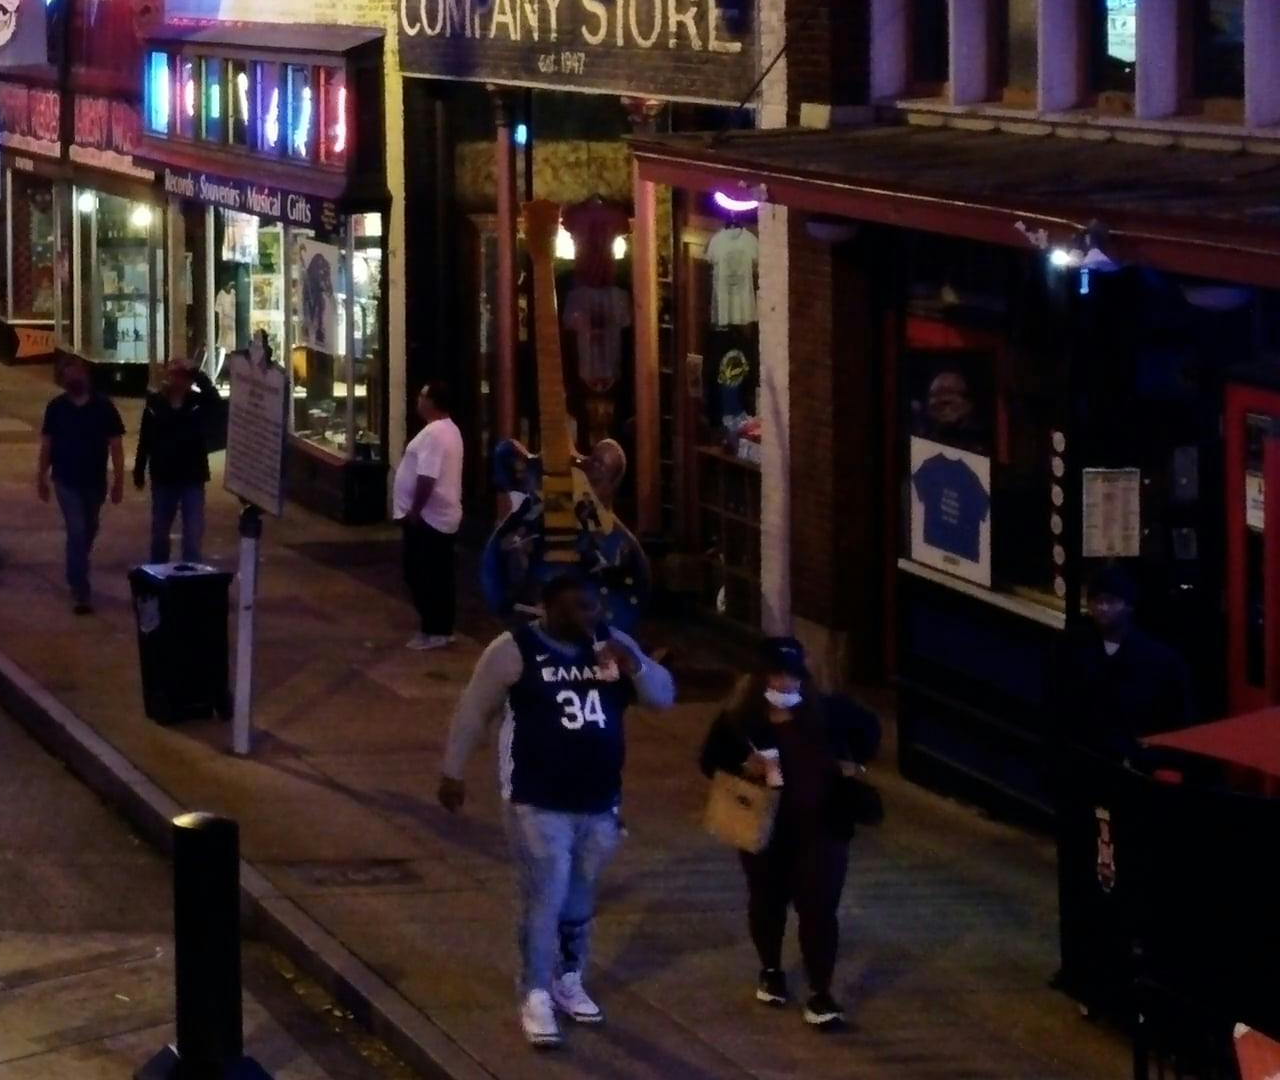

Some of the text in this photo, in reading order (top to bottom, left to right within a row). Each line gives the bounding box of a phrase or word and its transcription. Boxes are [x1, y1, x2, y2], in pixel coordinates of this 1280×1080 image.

[163, 167, 195, 198] Records
[199, 173, 241, 208] Souvenirs
[246, 184, 282, 217] Musical
[286, 193, 313, 224] Gifts
[555, 688, 608, 730] 34
